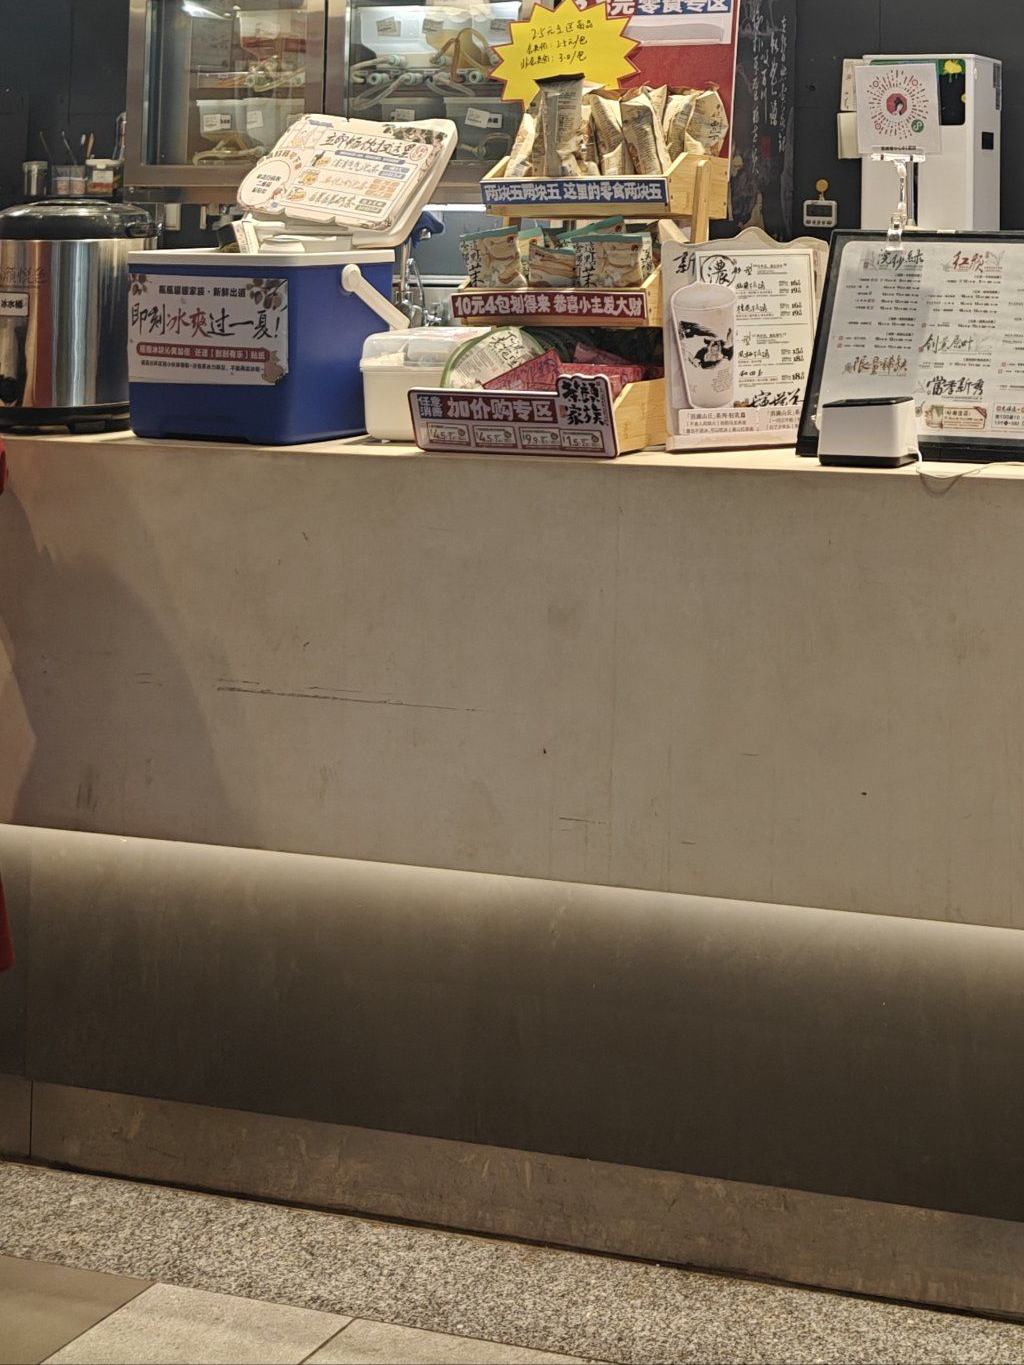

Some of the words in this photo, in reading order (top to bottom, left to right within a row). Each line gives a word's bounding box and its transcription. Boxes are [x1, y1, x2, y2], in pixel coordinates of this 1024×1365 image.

[455, 294, 550, 316] 10元4包划得来
[554, 295, 643, 316] 恭喜小主发大财
[447, 397, 554, 421] 加价购专区
